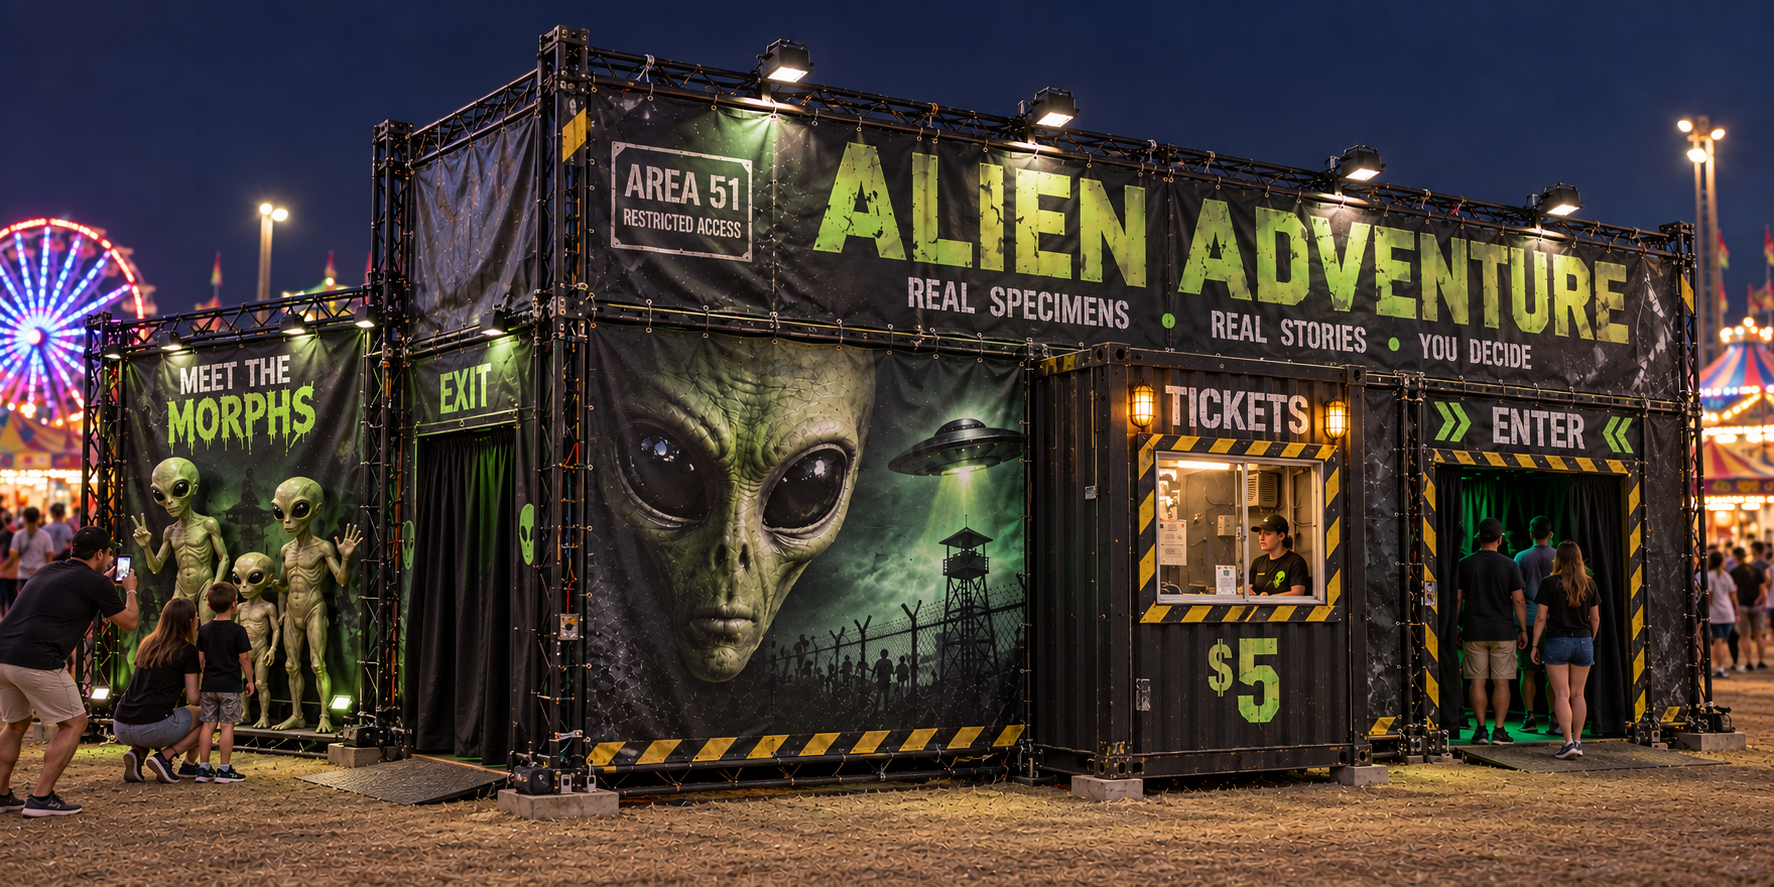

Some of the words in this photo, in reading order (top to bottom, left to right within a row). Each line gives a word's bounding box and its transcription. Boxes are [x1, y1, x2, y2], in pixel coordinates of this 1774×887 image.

[624, 163, 701, 206] AREA
[709, 174, 739, 211] 51
[623, 208, 694, 233] RESTRICTED
[697, 217, 742, 239] ACCESS
[813, 141, 1147, 288] ALIEN
[1178, 198, 1629, 344] ADVENTURE
[908, 276, 976, 314] REAL
[990, 286, 1130, 330] SPECIMENS
[1211, 310, 1268, 344] REAL
[1280, 318, 1367, 354] STORIES
[1418, 333, 1458, 362] YOU
[1469, 338, 1532, 370] DECIDE
[179, 361, 238, 395] MEET
[244, 354, 291, 388] THE
[440, 363, 492, 414] EXIT
[167, 380, 316, 456] MORPHS
[1165, 385, 1309, 435] TICKETS
[1492, 406, 1586, 450] ENTER
[1208, 637, 1280, 724] $5
